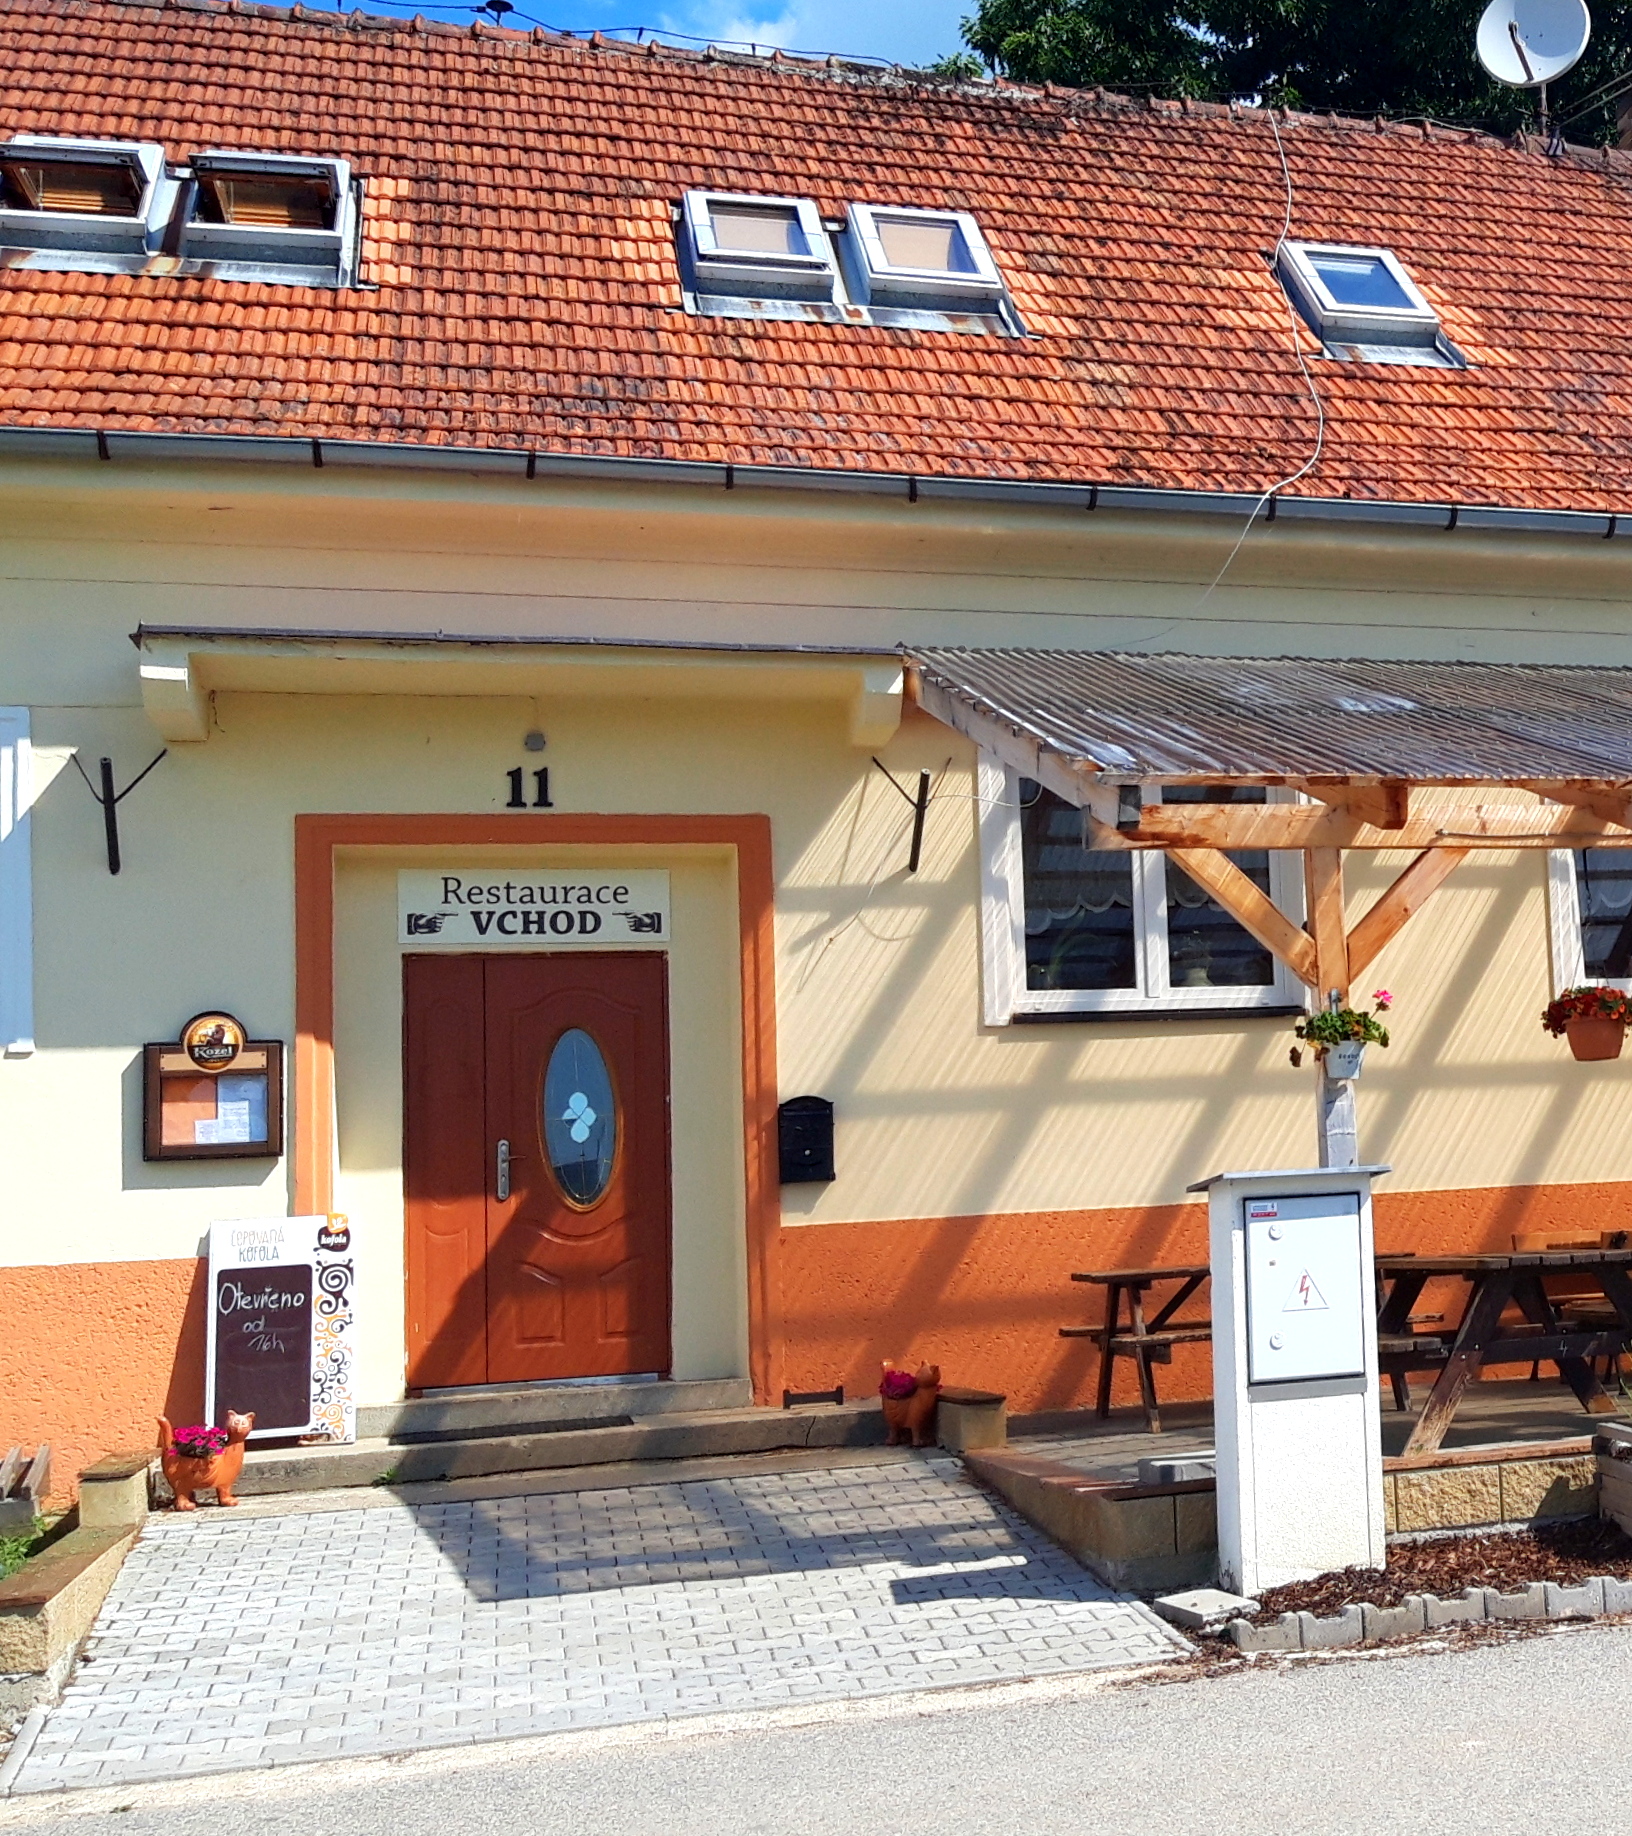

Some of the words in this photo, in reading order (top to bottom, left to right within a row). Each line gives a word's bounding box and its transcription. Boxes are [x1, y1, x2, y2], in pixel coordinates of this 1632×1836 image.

[506, 766, 554, 808] 11
[441, 876, 630, 905] Restaurace
[470, 910, 602, 935] VCHOD
[194, 1045, 233, 1058] Kozel
[320, 1233, 347, 1246] kofola
[239, 1246, 279, 1262] KOFOLA
[243, 1315, 266, 1333] od
